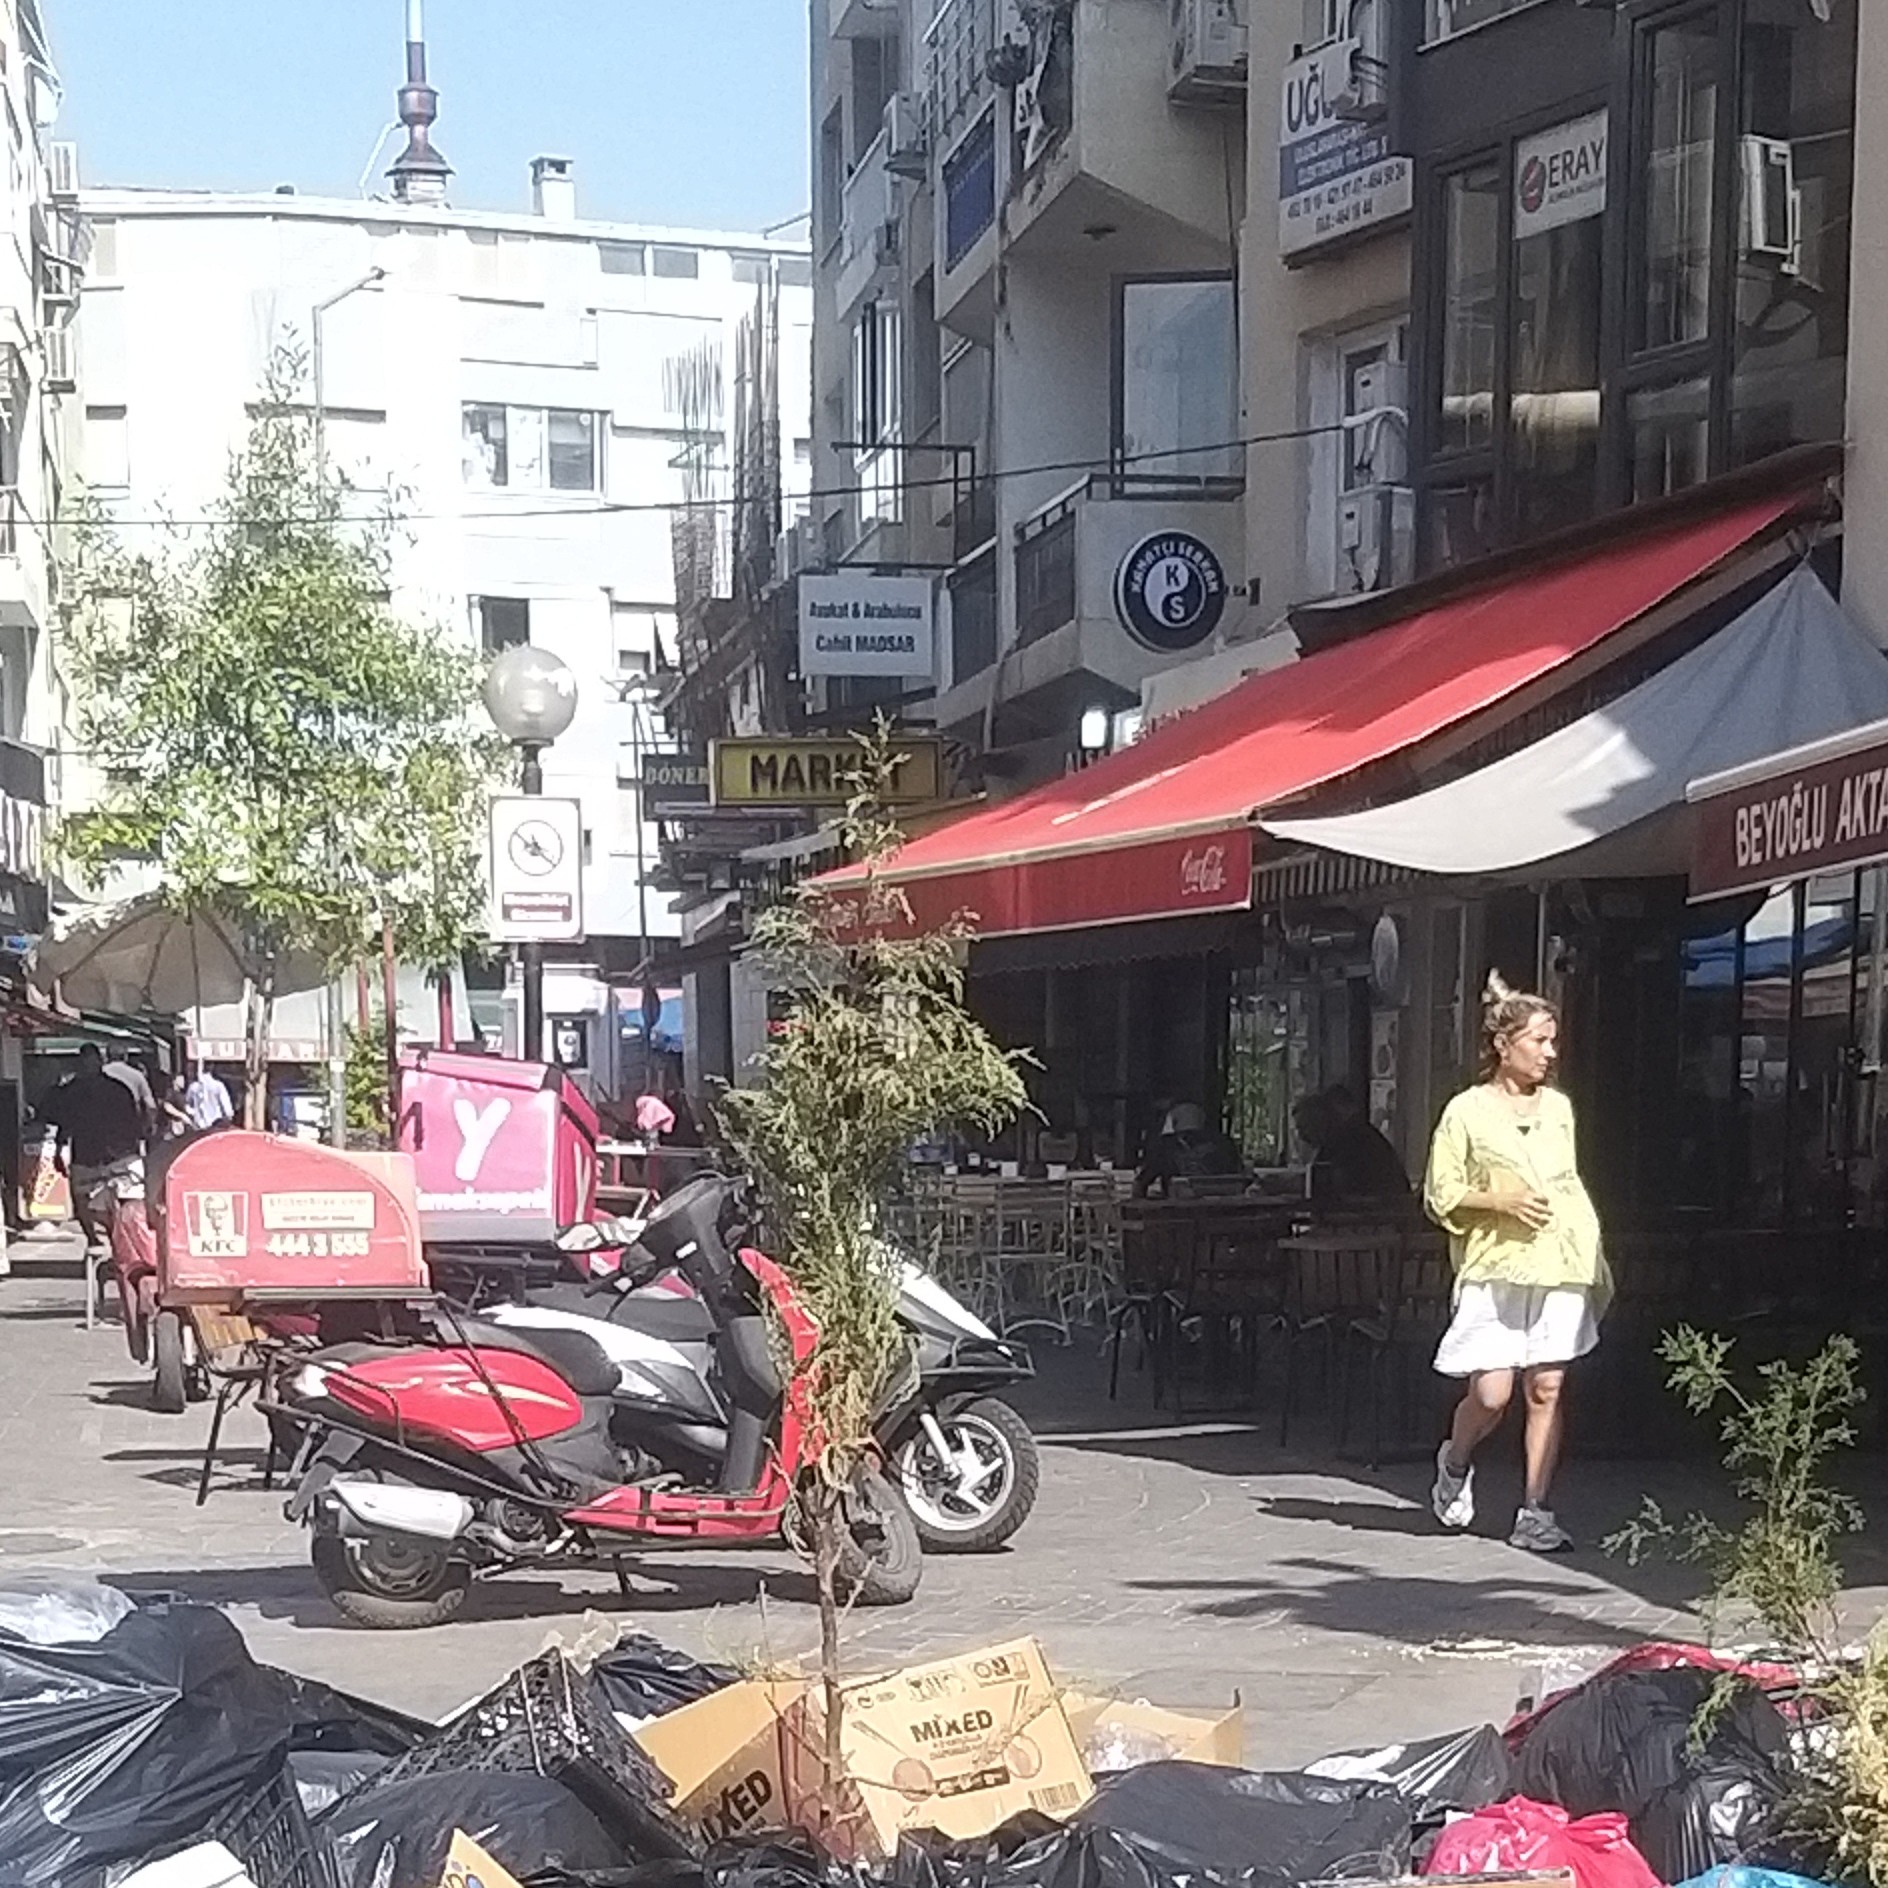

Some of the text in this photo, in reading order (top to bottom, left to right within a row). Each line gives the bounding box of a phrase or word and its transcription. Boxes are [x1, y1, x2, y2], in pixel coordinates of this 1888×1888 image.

[1549, 136, 1604, 188] ERAY
[1165, 564, 1180, 587] K
[852, 602, 860, 619] &
[1170, 595, 1185, 620] S
[816, 634, 852, 652] Cahit
[749, 753, 902, 794] MARKT
[1735, 780, 1829, 869] BEYOĞLU
[453, 1096, 512, 1182] Y
[201, 1240, 235, 1252] KFC
[265, 1232, 311, 1257] 444
[330, 1232, 369, 1257] 555
[700, 1770, 772, 1845] IXED
